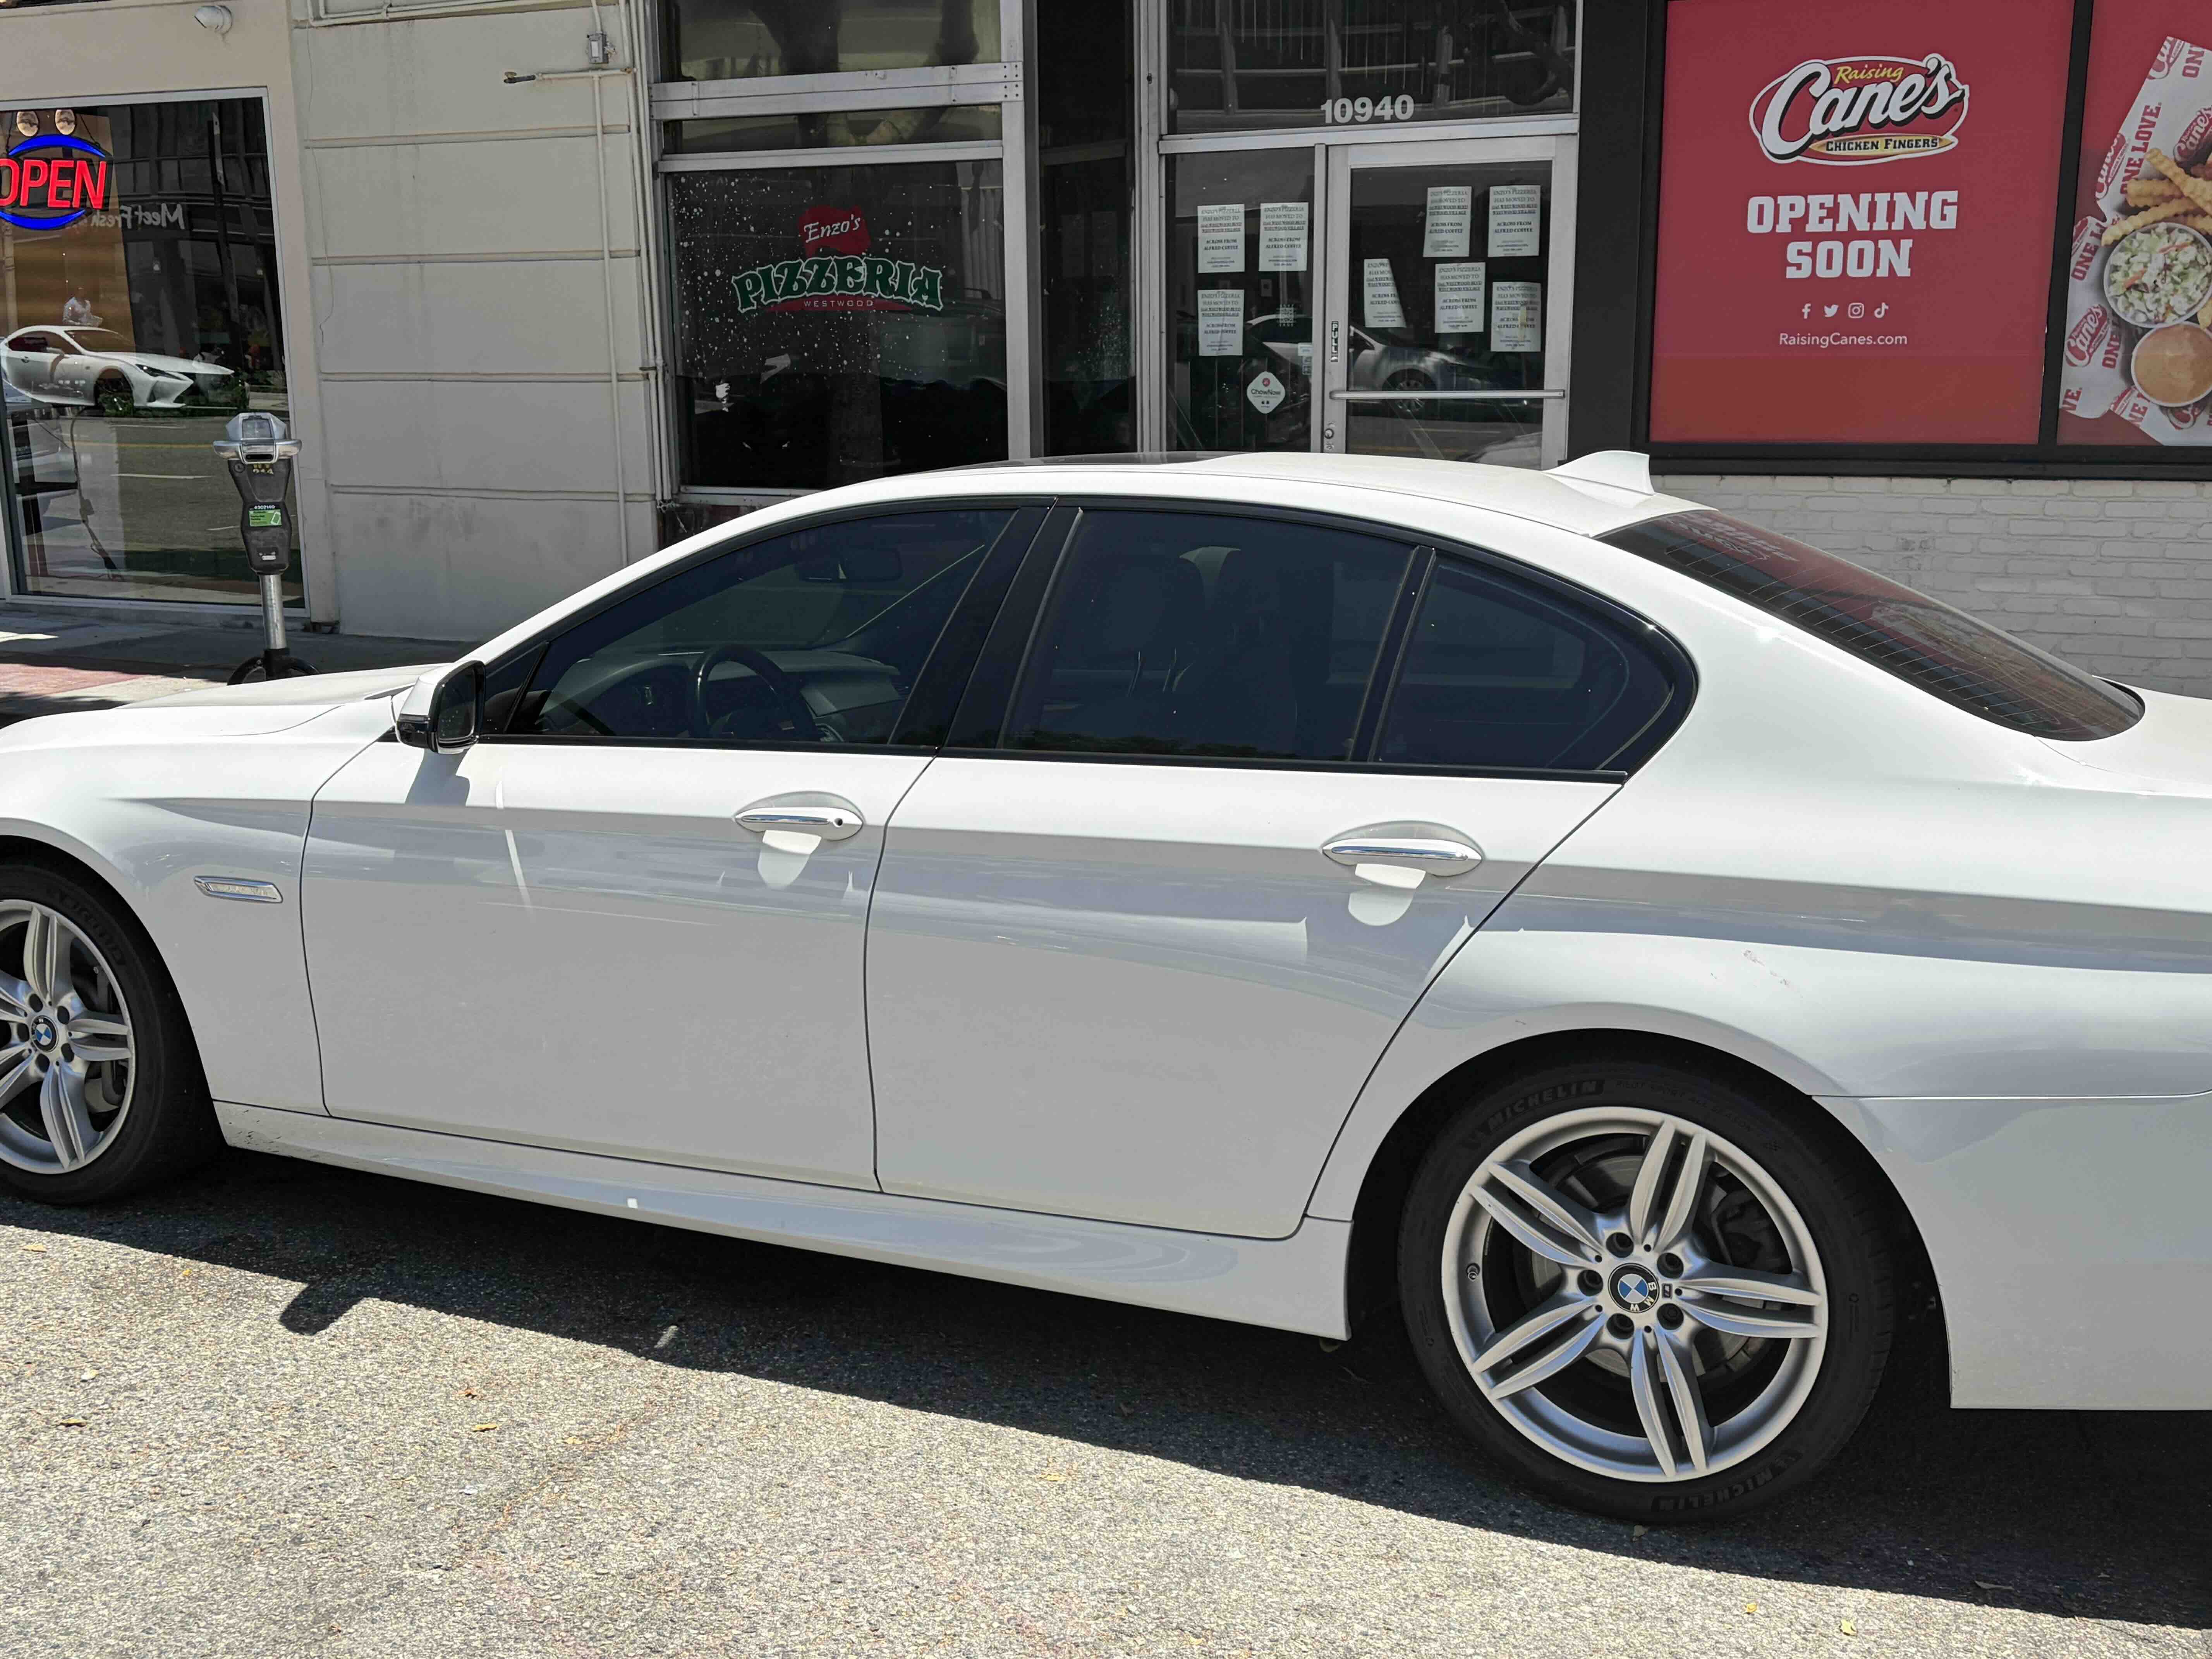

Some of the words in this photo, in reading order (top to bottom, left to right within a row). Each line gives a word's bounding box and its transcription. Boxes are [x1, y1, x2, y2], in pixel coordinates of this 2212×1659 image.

[1833, 64, 1904, 84] Raising
[1320, 94, 1414, 124] 10940
[1762, 57, 1965, 156] Cane's
[1826, 140, 1879, 151] CHICKEN
[1884, 138, 1937, 150] FINGERS
[0, 158, 106, 209] OPEN
[804, 213, 861, 243] Enzo's
[1747, 191, 1958, 233] OPENING
[1786, 239, 1913, 278] SOON
[2071, 241, 2099, 281] ONE
[731, 255, 943, 313] PIZZERIA
[1779, 332, 1908, 348] RaisingCanes.com
[1487, 1080, 1598, 1132] MICHELIN
[1630, 1281, 1657, 1312] BMW
